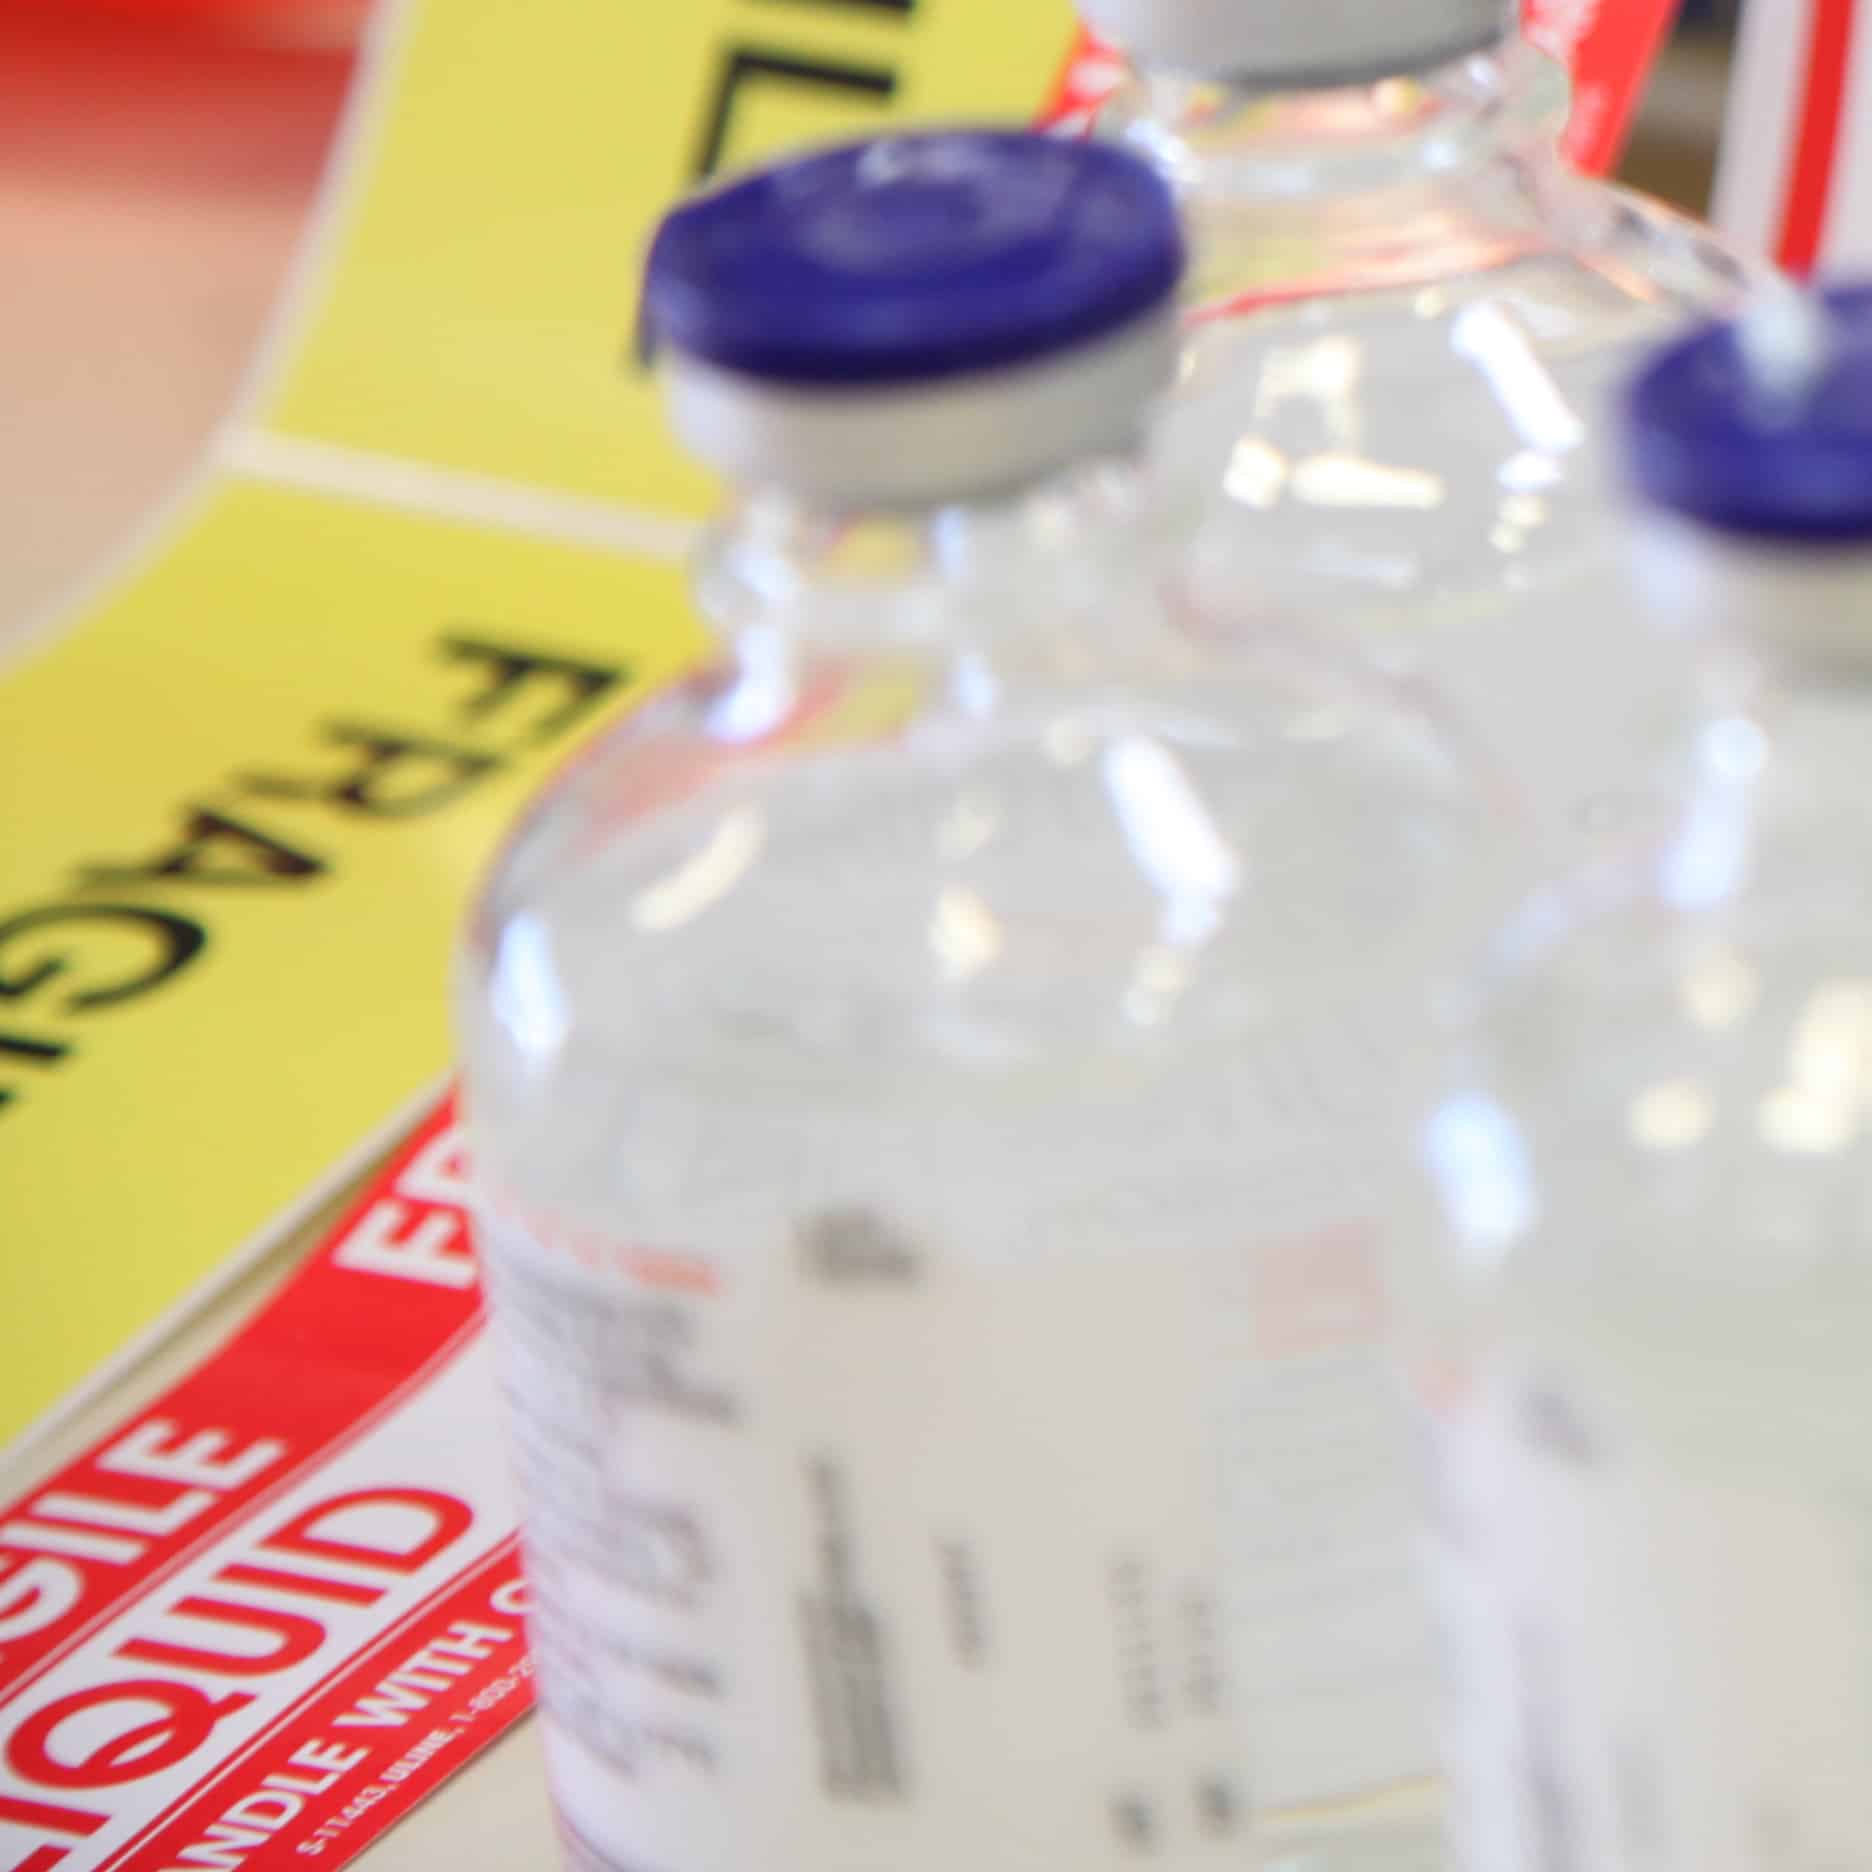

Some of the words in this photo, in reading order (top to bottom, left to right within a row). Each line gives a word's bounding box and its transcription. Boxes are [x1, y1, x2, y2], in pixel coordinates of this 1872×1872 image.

[0, 628, 632, 1068] FRAG
[0, 1416, 288, 1648] GILE
[0, 1486, 475, 1872] IQUID
[157, 1738, 372, 1872] NDLE
[332, 1620, 514, 1728] WITH
[379, 1726, 466, 1783] ULINE,
